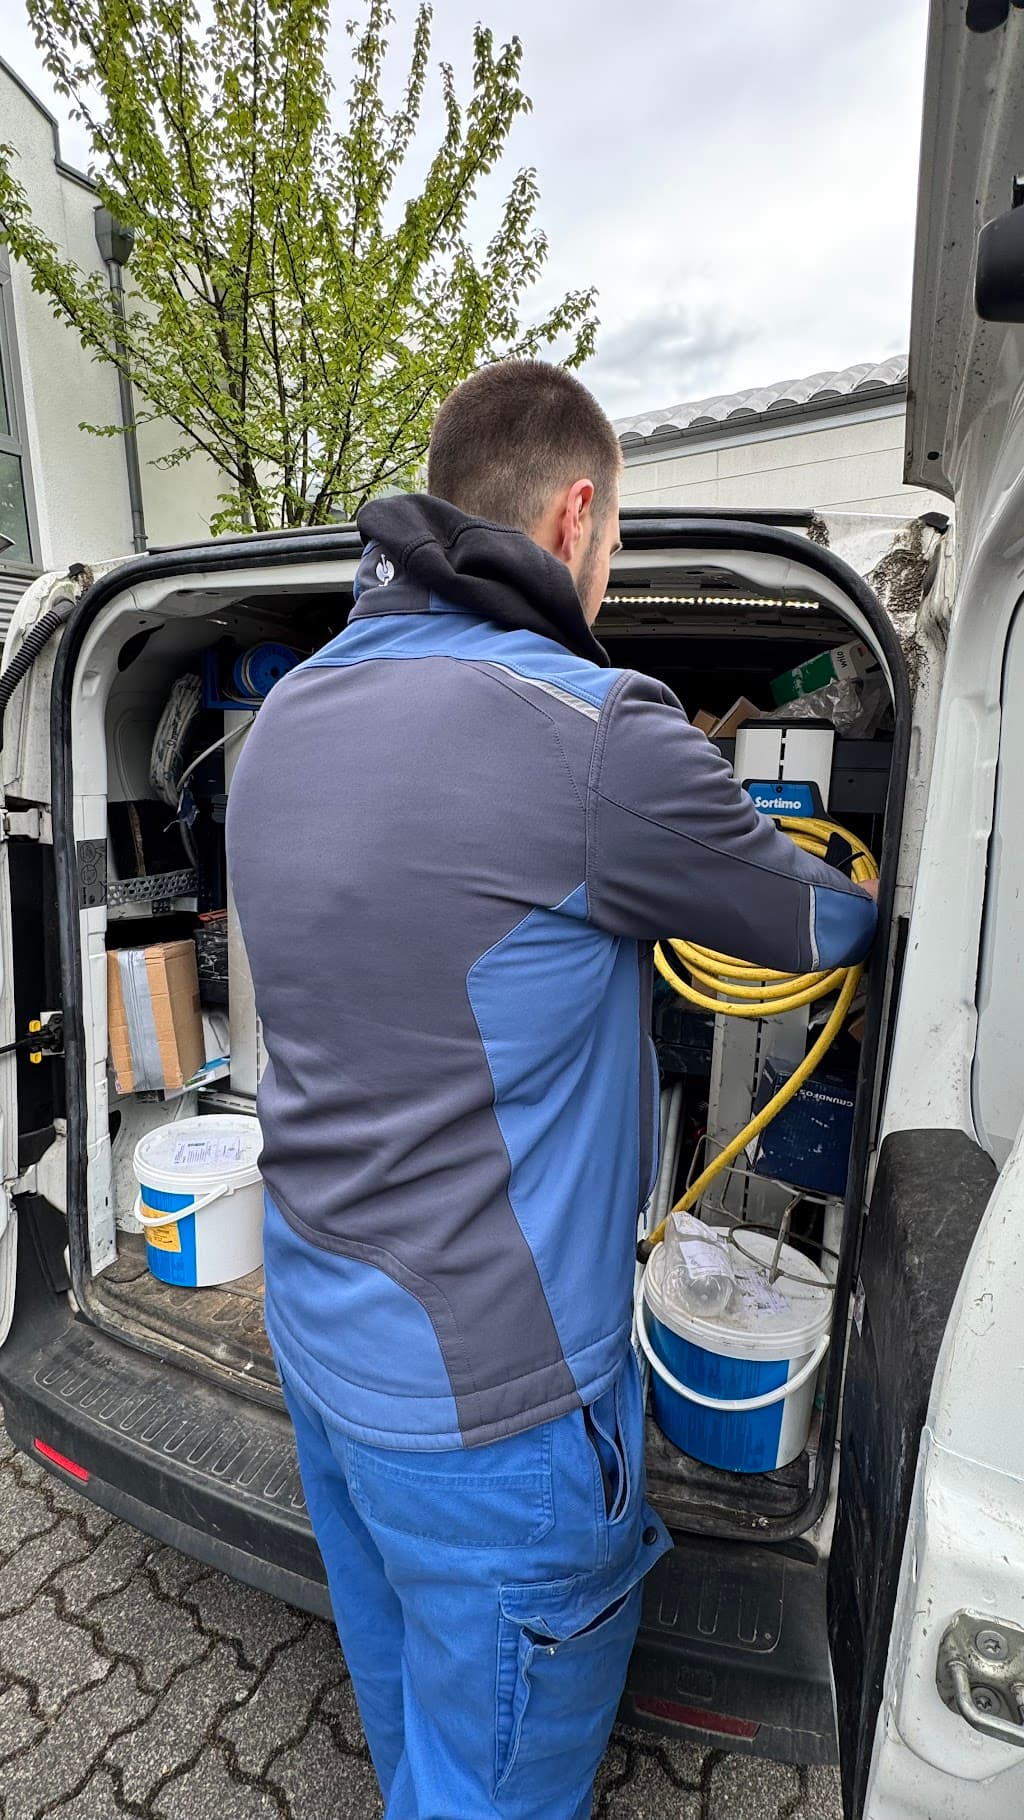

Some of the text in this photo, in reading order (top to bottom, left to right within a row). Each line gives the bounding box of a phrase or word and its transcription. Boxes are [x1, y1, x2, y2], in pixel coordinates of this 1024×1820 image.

[837, 651, 848, 668] wilo
[754, 796, 802, 810] Sortimo
[799, 1089, 854, 1108] GRUNDFOS
